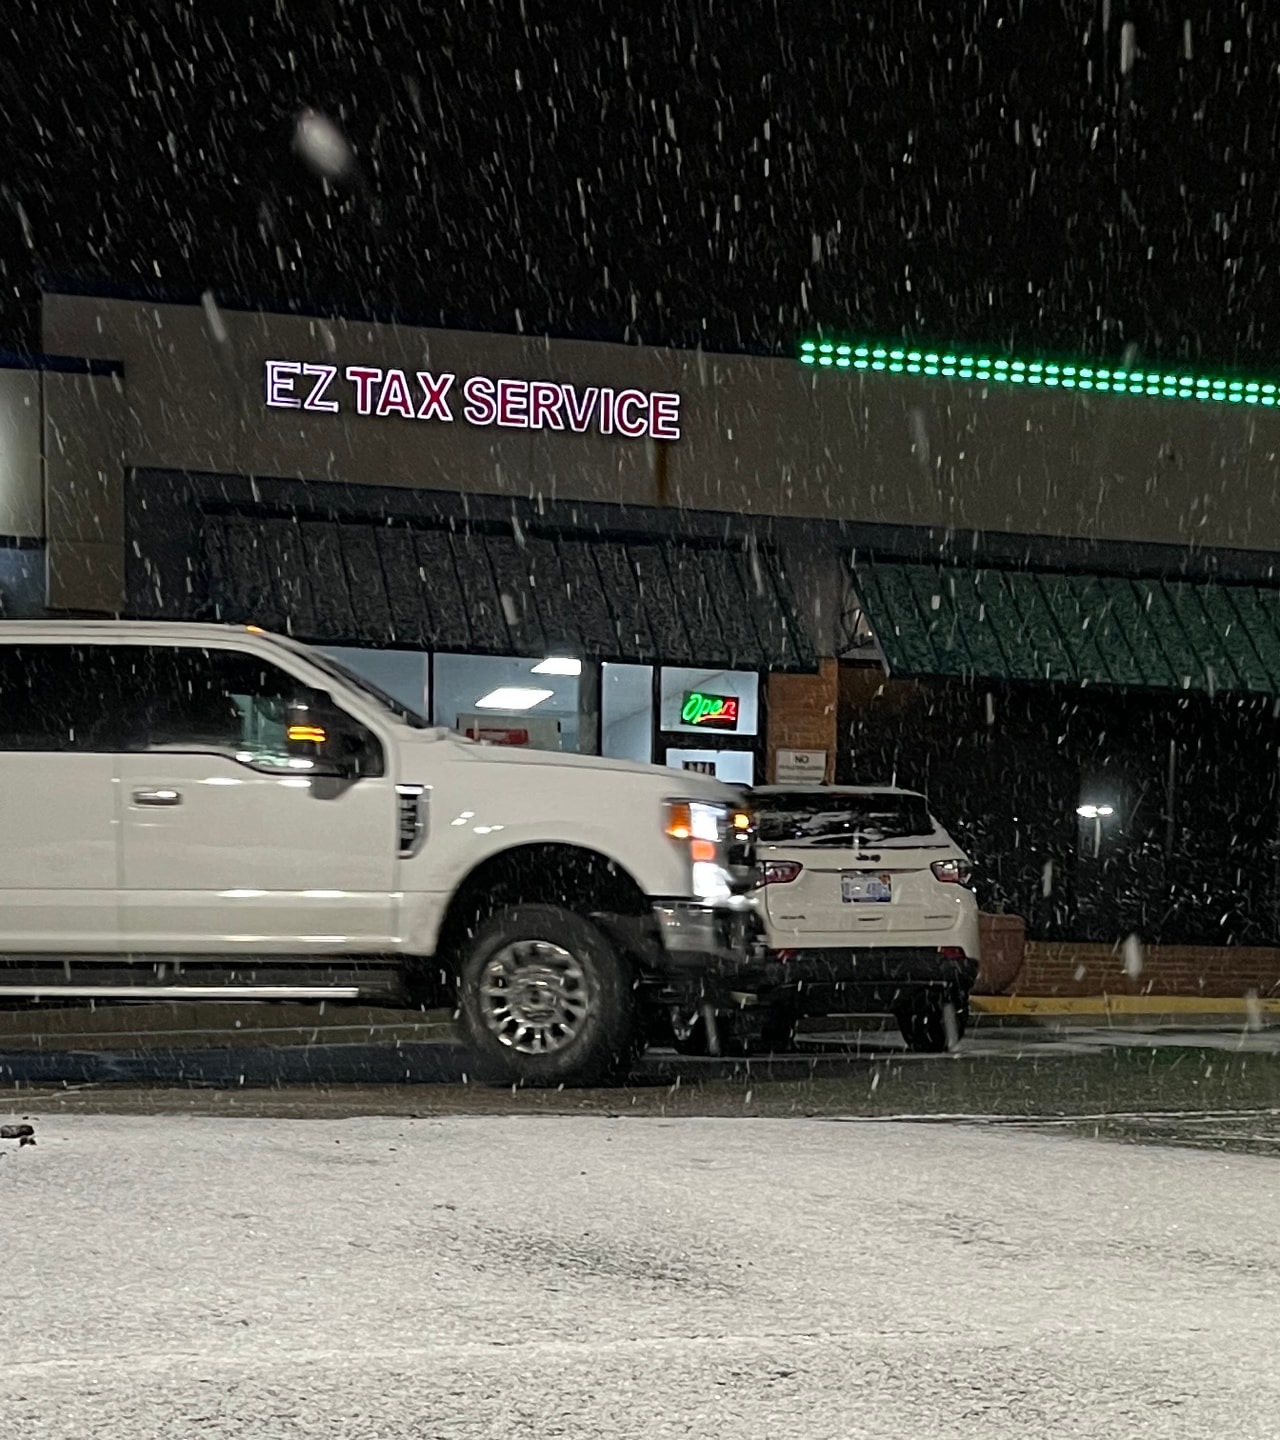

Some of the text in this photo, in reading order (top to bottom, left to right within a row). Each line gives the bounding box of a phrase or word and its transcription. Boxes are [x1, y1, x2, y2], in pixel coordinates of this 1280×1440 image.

[265, 360, 681, 440] EZ TAX SERVICE
[681, 693, 736, 725] Open
[795, 754, 810, 764] NO
